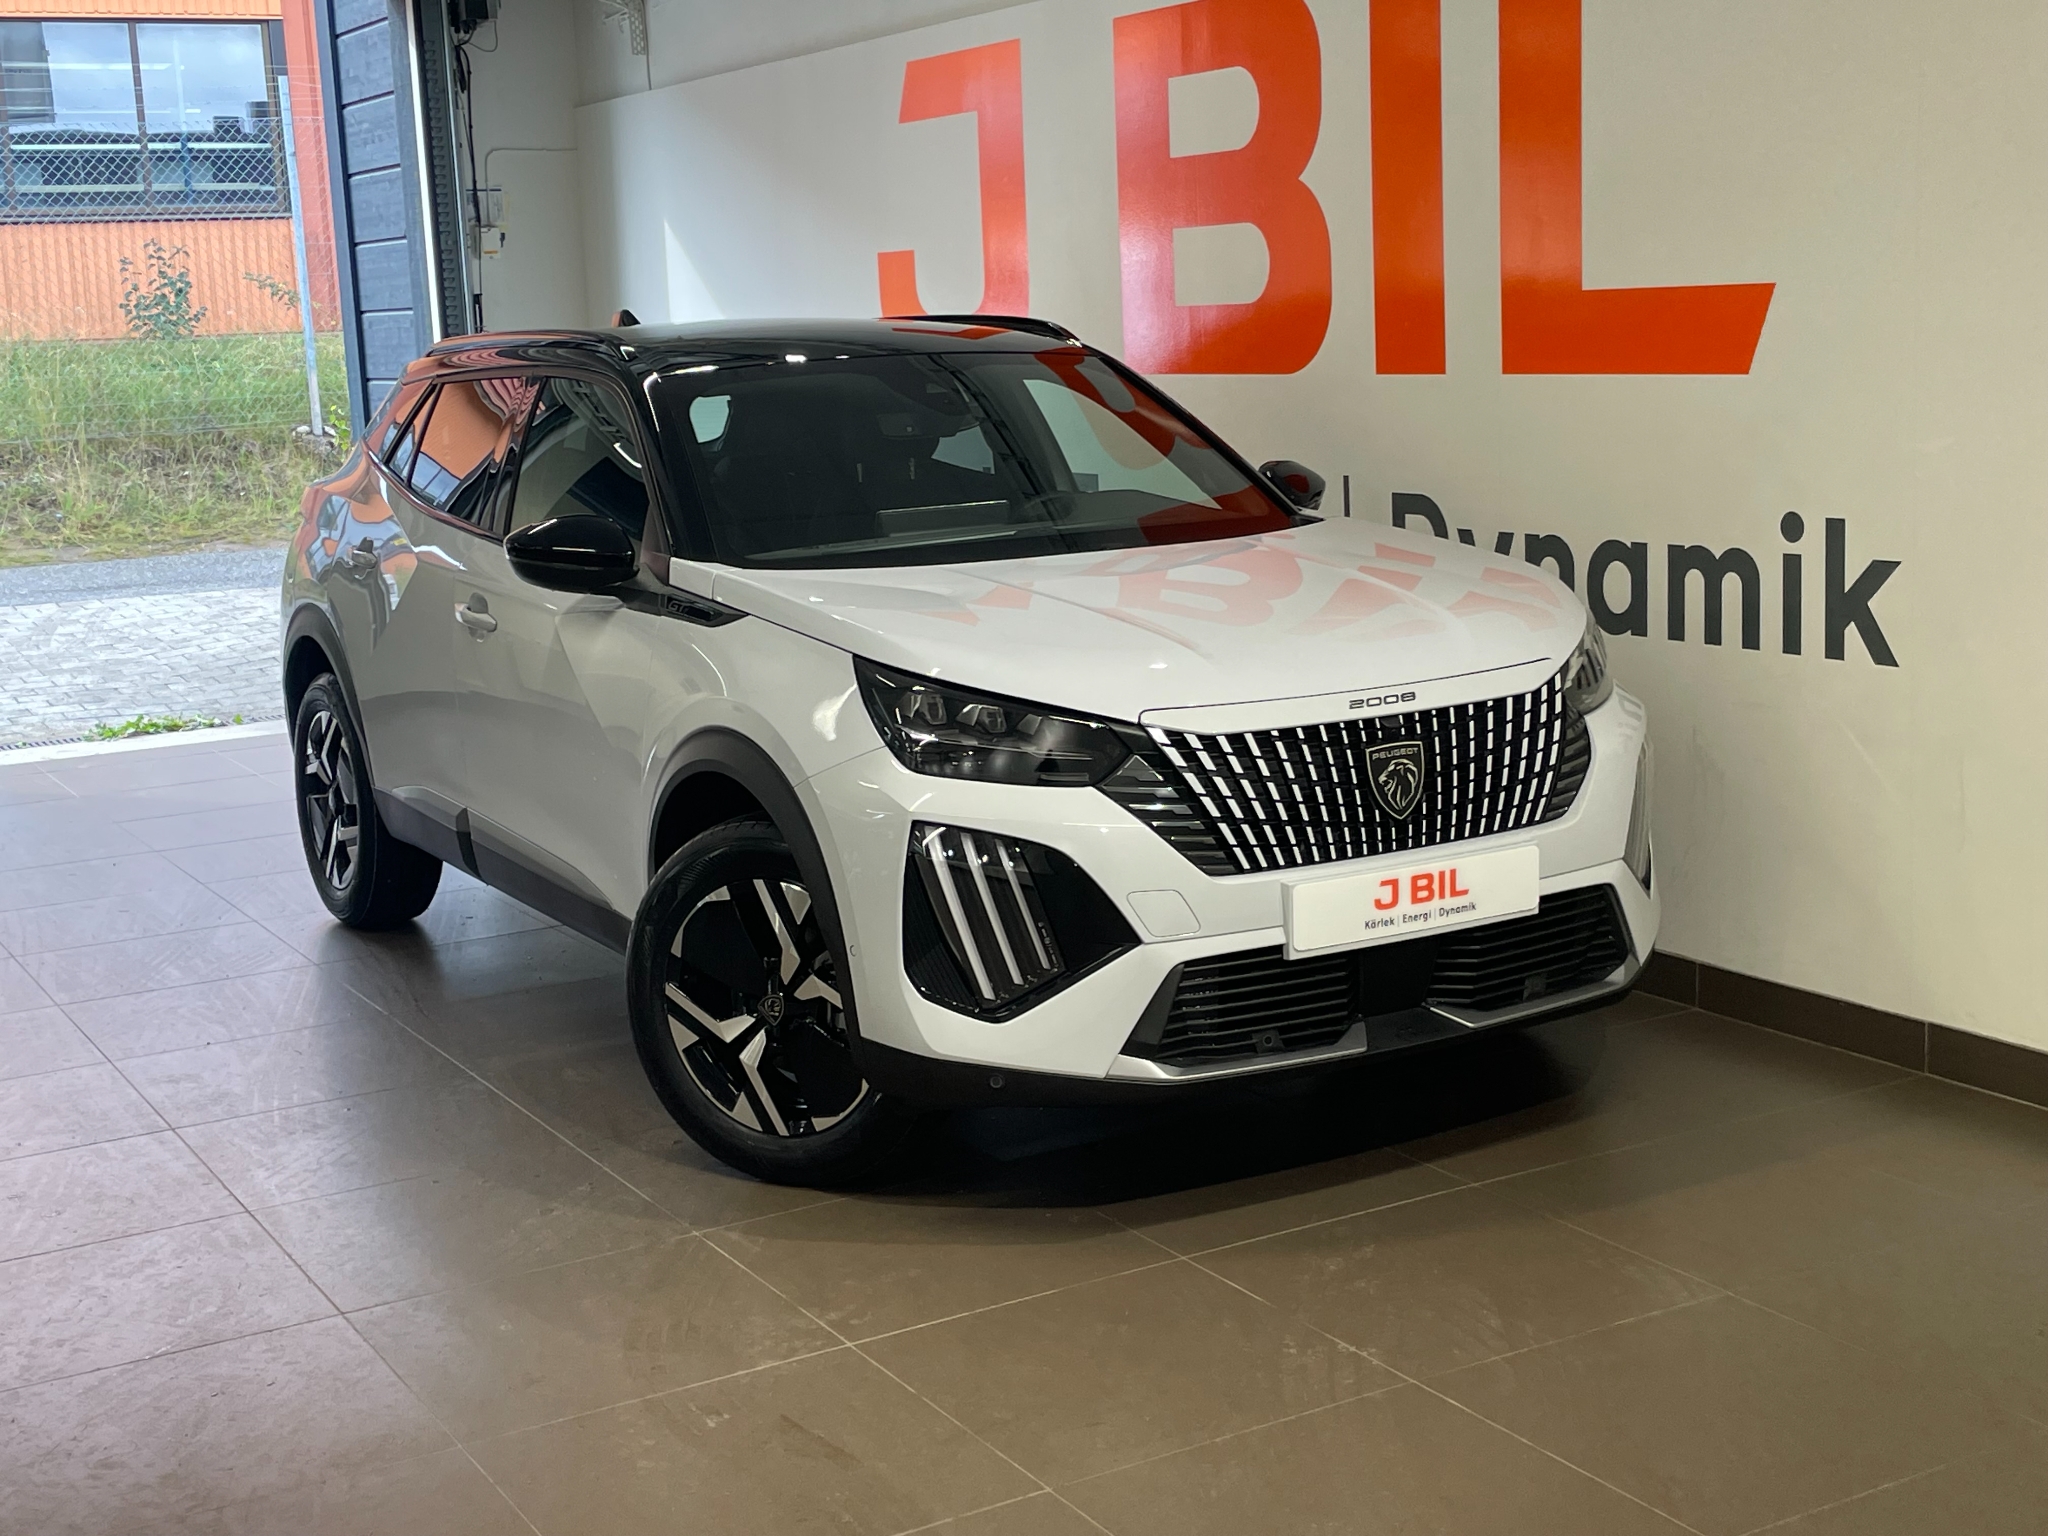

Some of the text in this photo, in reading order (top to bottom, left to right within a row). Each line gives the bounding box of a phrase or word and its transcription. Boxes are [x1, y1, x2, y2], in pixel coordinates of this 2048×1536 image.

[877, 0, 1776, 375] J BIL
[1391, 493, 1901, 667] namik
[1349, 691, 1416, 709] 2008
[1372, 747, 1419, 760] PEUGEOT
[1373, 868, 1469, 911] J BIL
[1364, 902, 1476, 930] Kärlek Energi Dynamik
